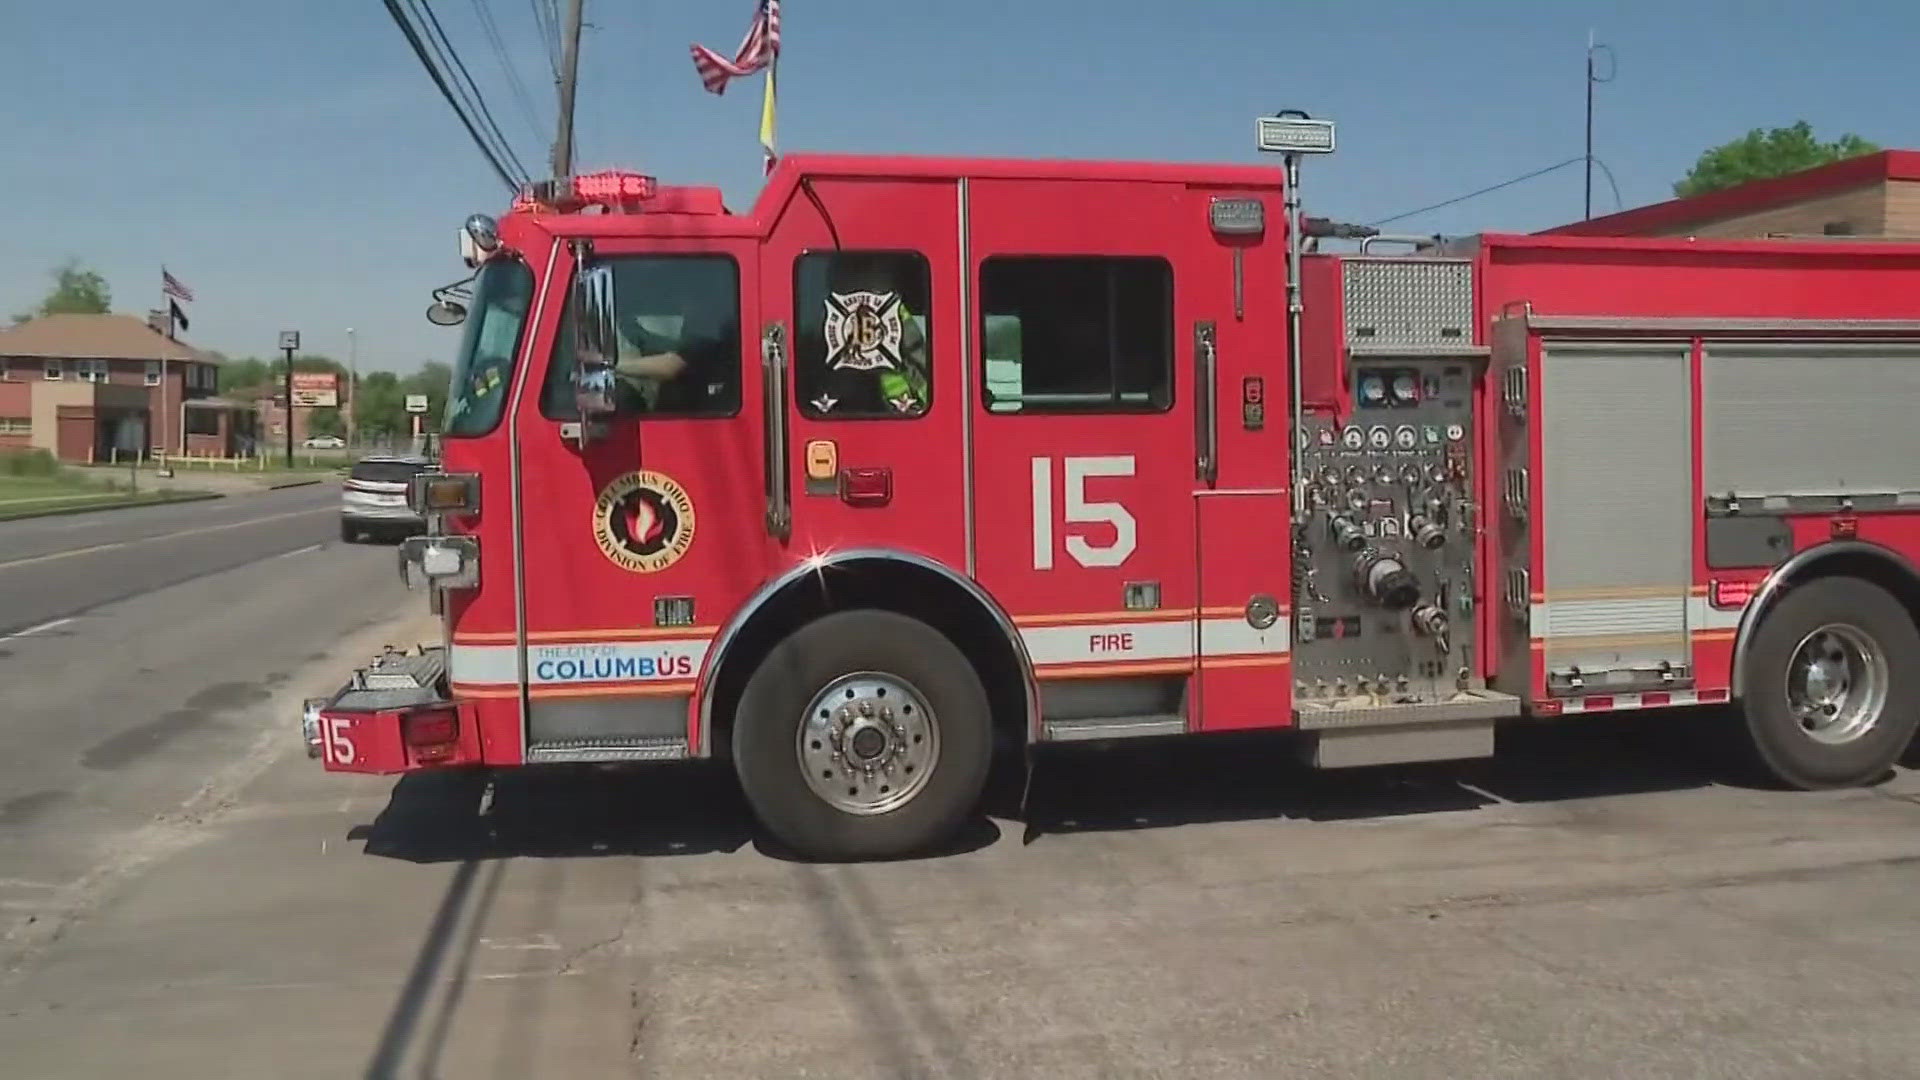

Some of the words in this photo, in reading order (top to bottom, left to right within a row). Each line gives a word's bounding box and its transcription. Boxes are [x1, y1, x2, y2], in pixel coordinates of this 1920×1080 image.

[663, 481, 690, 512] OHIO
[1031, 455, 1137, 570] 15
[596, 528, 646, 570] DIVISION
[653, 555, 671, 569] OF
[673, 525, 692, 555] FIRE
[539, 647, 560, 658] THE
[567, 645, 597, 657] CITY
[1089, 632, 1134, 653] FIRE
[537, 656, 692, 680] COLUMBUS
[320, 716, 355, 764] 15
